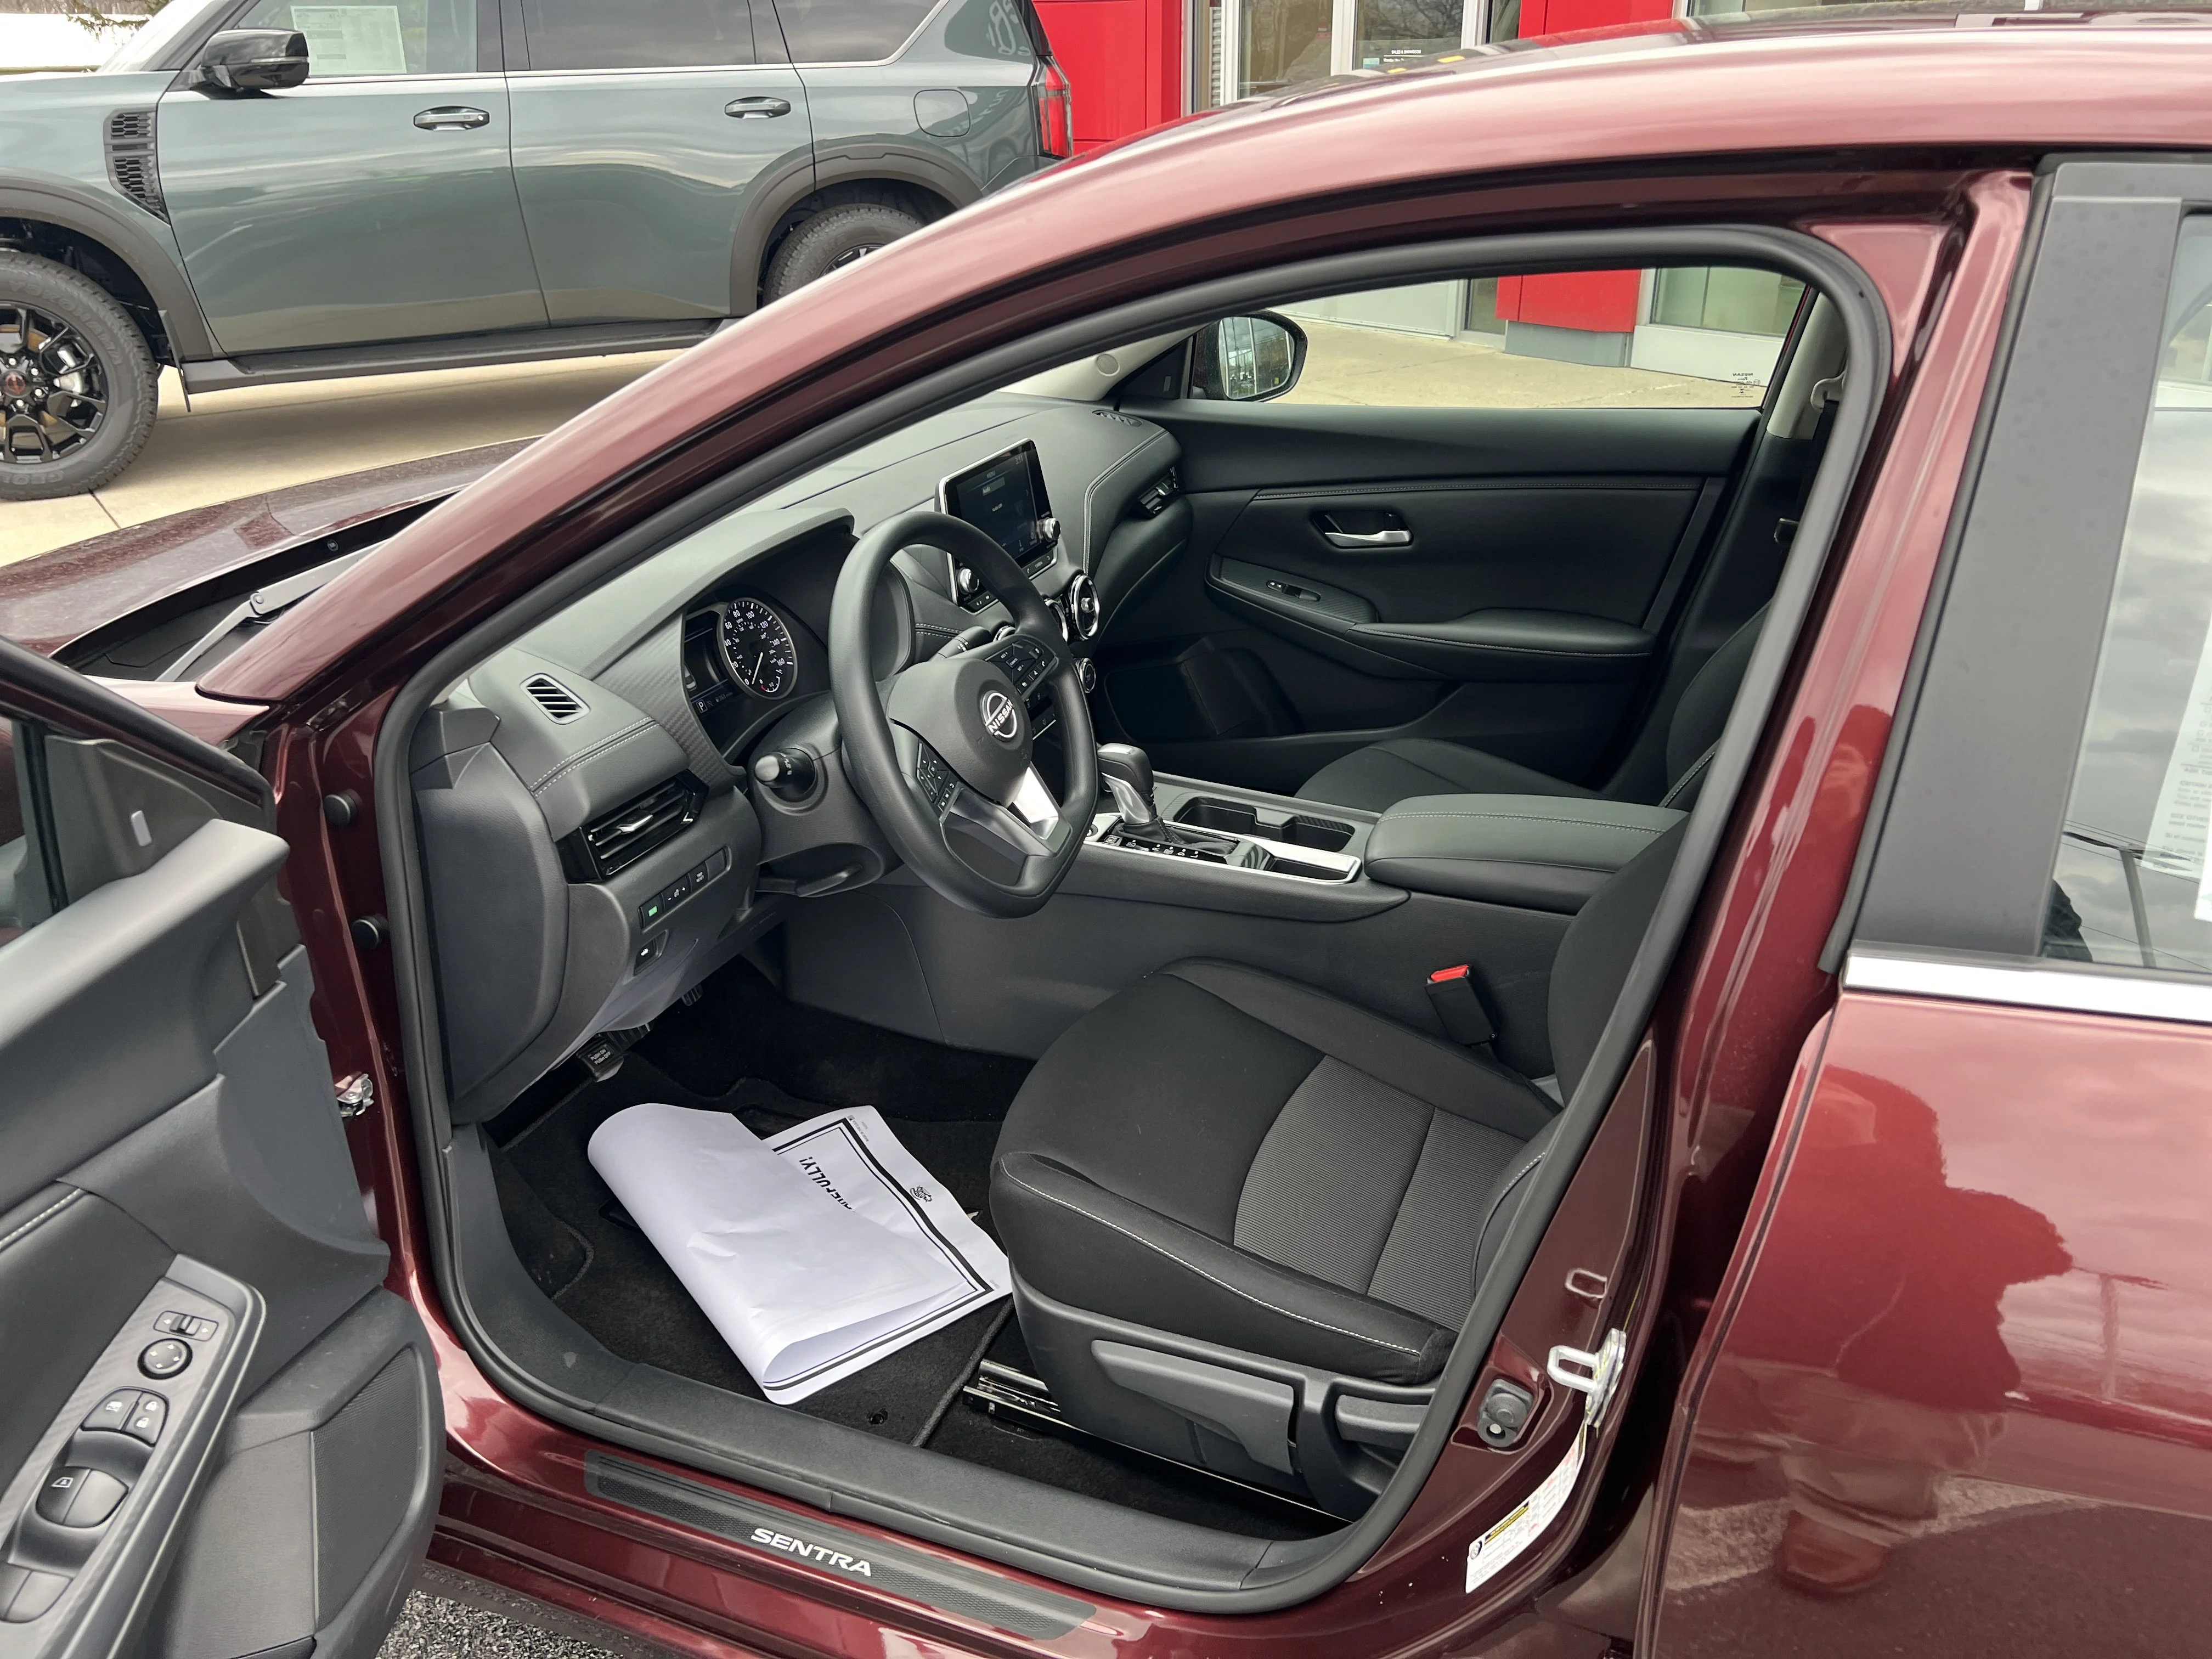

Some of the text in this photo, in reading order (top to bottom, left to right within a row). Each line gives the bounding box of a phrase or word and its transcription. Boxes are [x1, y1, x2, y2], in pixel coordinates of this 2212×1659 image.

[733, 610, 741, 618] 80
[746, 611, 754, 619] 100
[725, 621, 732, 629] 60
[760, 620, 768, 629] 120
[772, 638, 780, 646] 140
[776, 658, 785, 667] 160
[988, 699, 1013, 733] NISSAN
[751, 1528, 871, 1577] SENTRA
